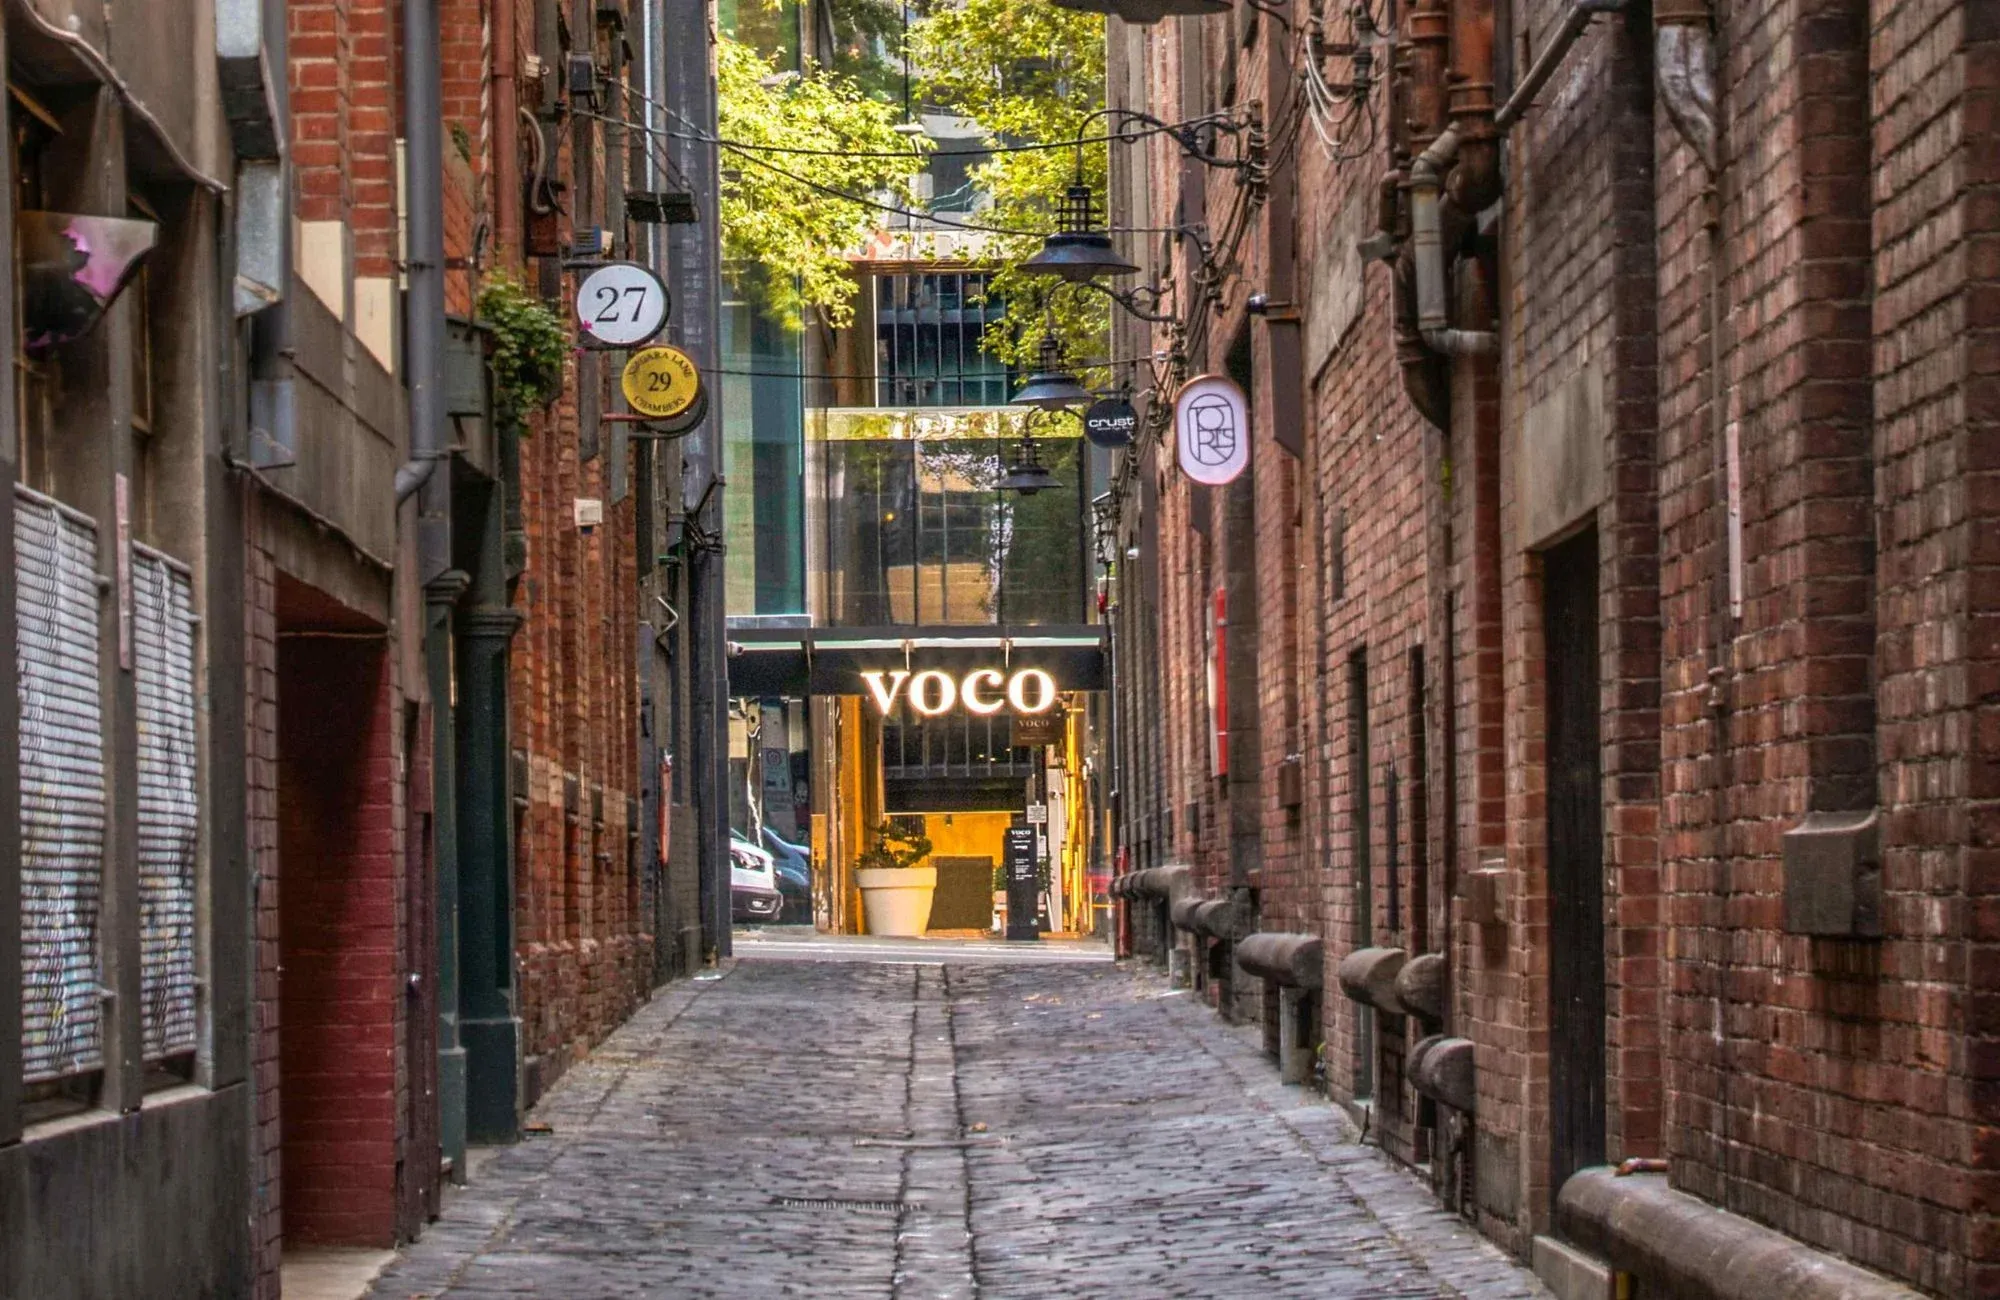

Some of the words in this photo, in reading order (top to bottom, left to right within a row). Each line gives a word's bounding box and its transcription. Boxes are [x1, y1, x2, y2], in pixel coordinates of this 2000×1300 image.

[595, 286, 647, 323] 27
[672, 353, 692, 378] LANE
[648, 372, 671, 392] 29
[634, 395, 686, 412] CHAMBERS
[1088, 416, 1135, 428] crust
